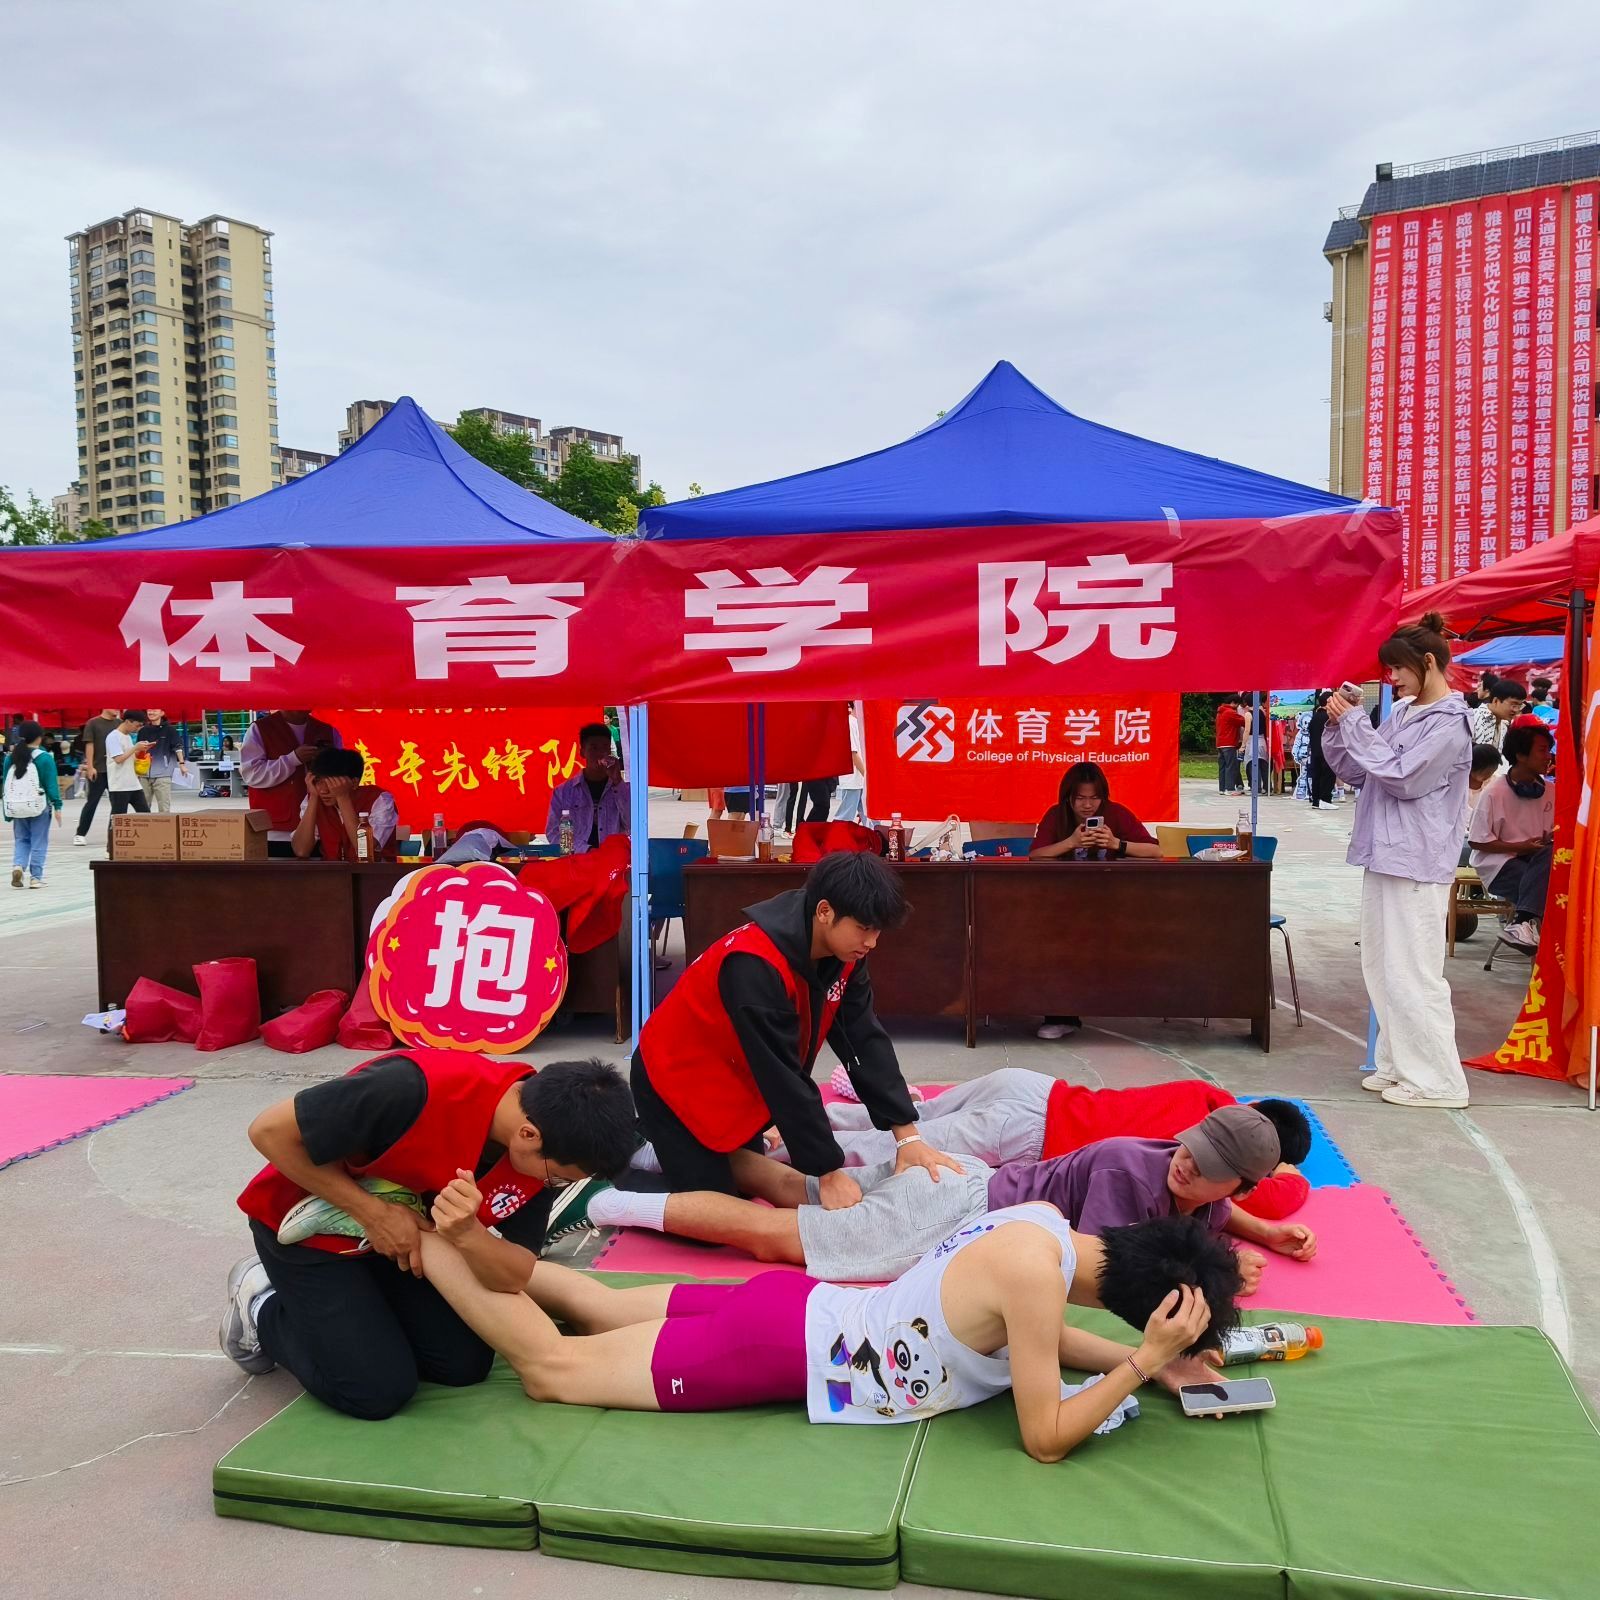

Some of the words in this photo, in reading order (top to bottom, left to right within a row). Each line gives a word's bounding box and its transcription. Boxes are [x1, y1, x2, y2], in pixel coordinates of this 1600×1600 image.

[118, 553, 1178, 682] 体育学院
[966, 708, 1151, 745] 体育学院
[966, 750, 1013, 764] College
[1016, 751, 1029, 762] of
[1032, 750, 1085, 764] Physical
[1088, 751, 1150, 763] Education
[115, 829, 140, 838] 打工人
[182, 829, 208, 838] 打工人
[424, 900, 534, 1016] 抱
